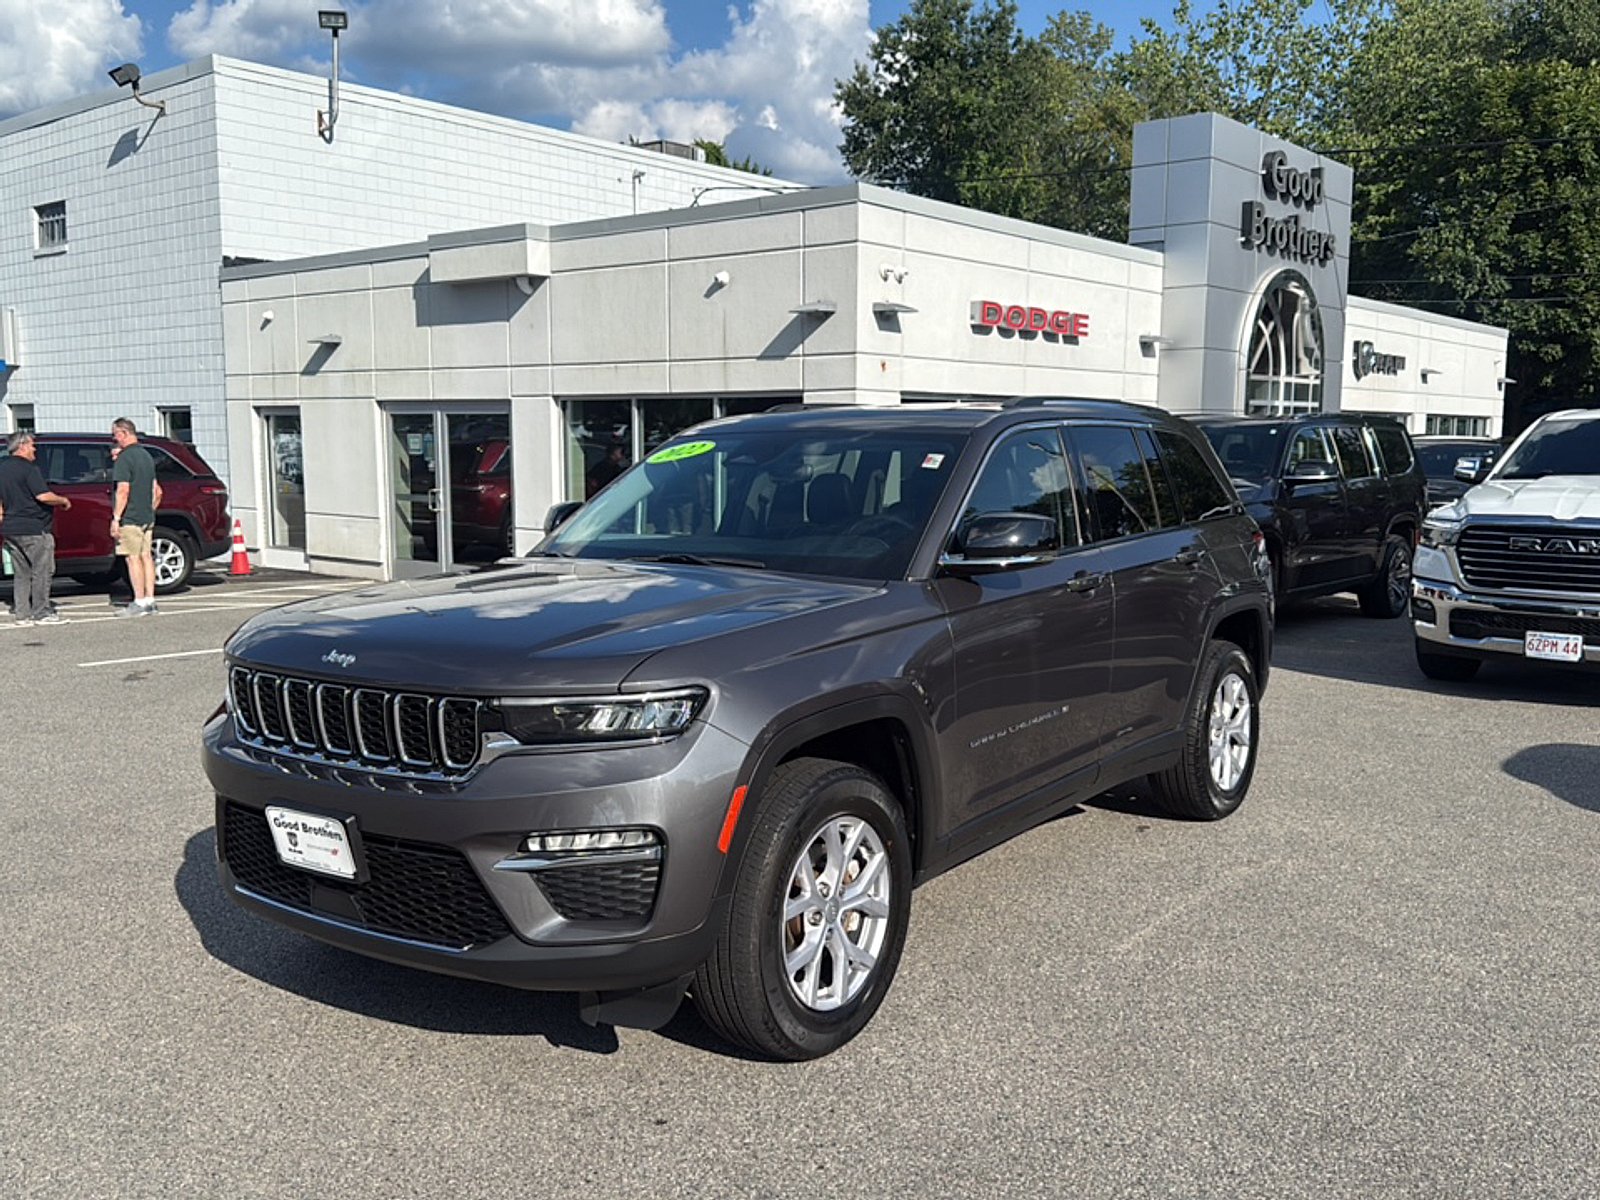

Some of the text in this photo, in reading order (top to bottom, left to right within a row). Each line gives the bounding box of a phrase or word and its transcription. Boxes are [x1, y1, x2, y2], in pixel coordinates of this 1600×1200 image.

[1261, 150, 1324, 206] Good
[1241, 200, 1336, 262] Brothers
[972, 300, 1090, 337] DODGE
[321, 649, 356, 668] Jeep
[1562, 641, 1578, 655] 44
[273, 816, 300, 832] Good
